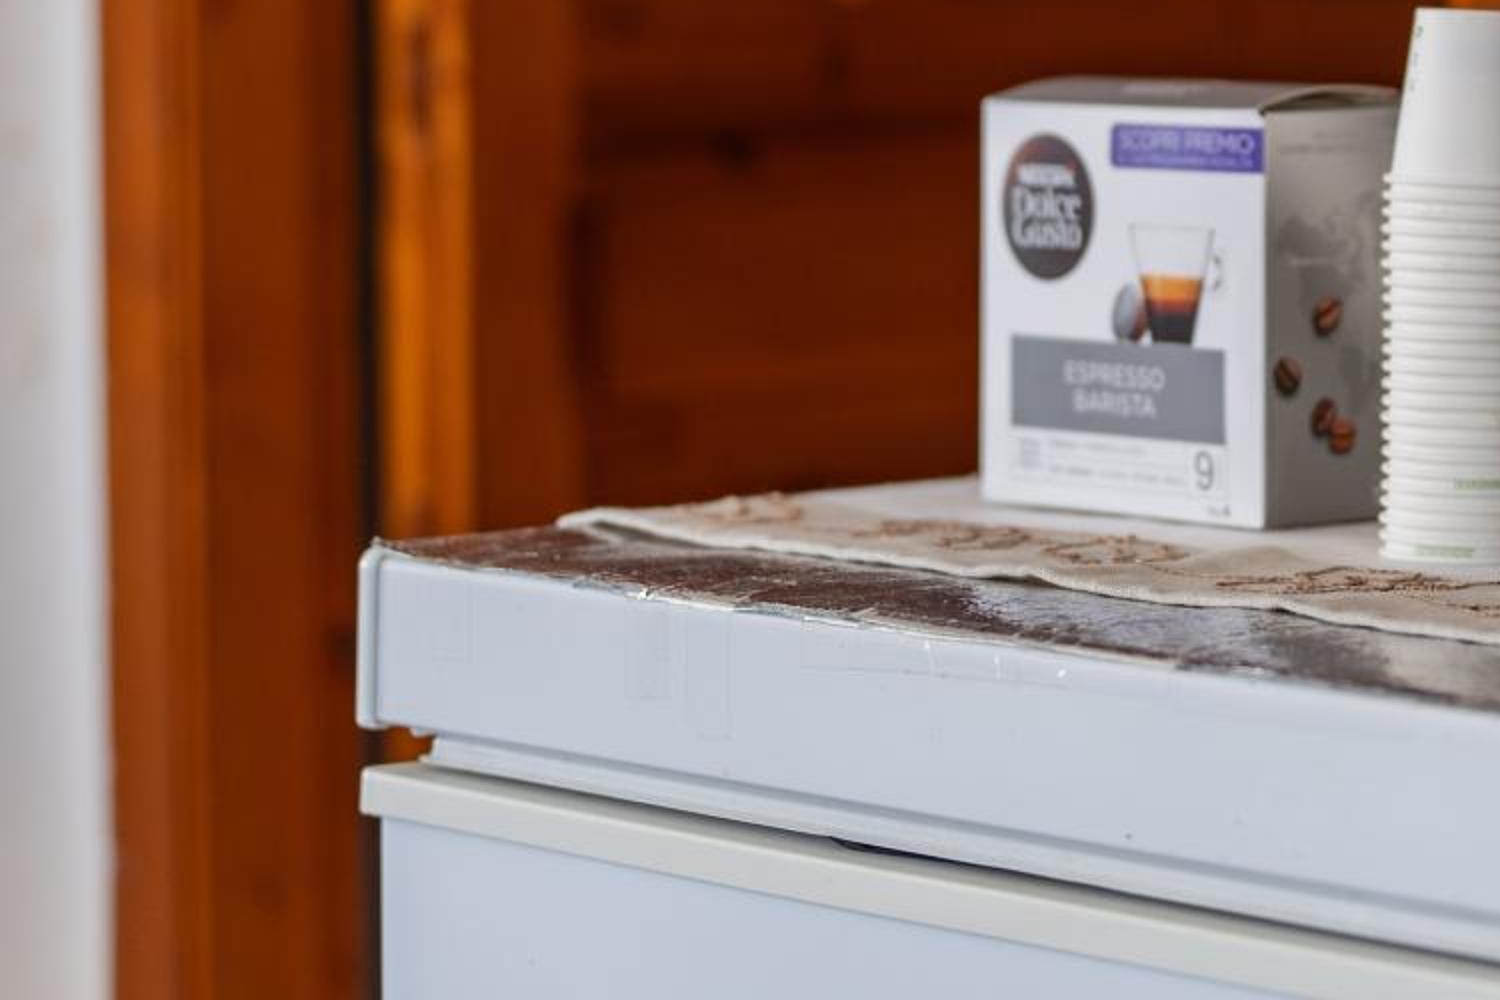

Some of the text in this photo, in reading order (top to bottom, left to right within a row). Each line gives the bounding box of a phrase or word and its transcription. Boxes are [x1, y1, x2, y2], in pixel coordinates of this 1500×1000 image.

[1012, 184, 1082, 218] Dolce
[1012, 215, 1083, 249] Gusto
[1063, 359, 1166, 391] ESPRESSO
[1073, 388, 1158, 419] BARISTA
[1194, 450, 1215, 491] 9
